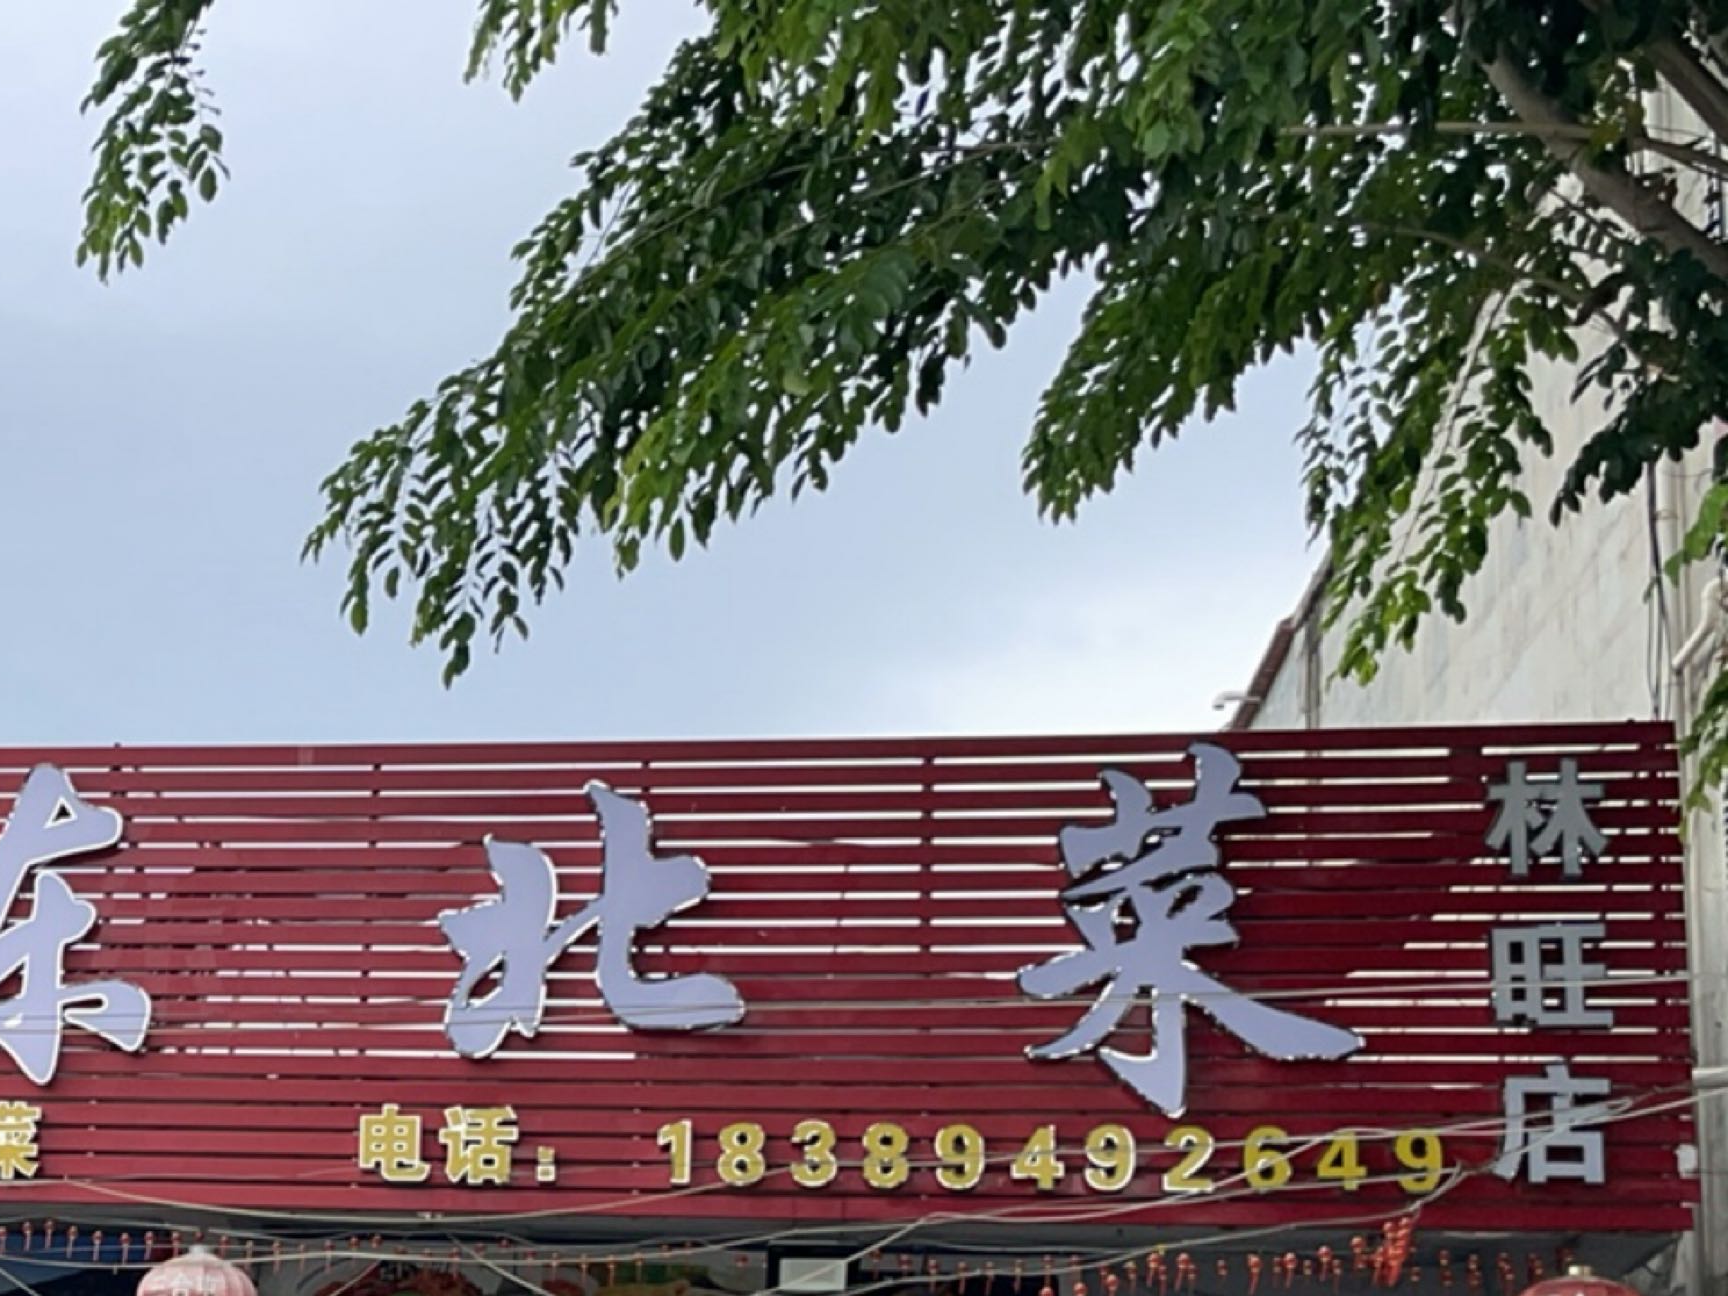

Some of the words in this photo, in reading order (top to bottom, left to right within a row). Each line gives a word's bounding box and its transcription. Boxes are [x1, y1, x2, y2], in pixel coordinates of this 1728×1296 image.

[1486, 757, 1614, 1184] 林旺店
[655, 1124, 1443, 1193] 18389492649
